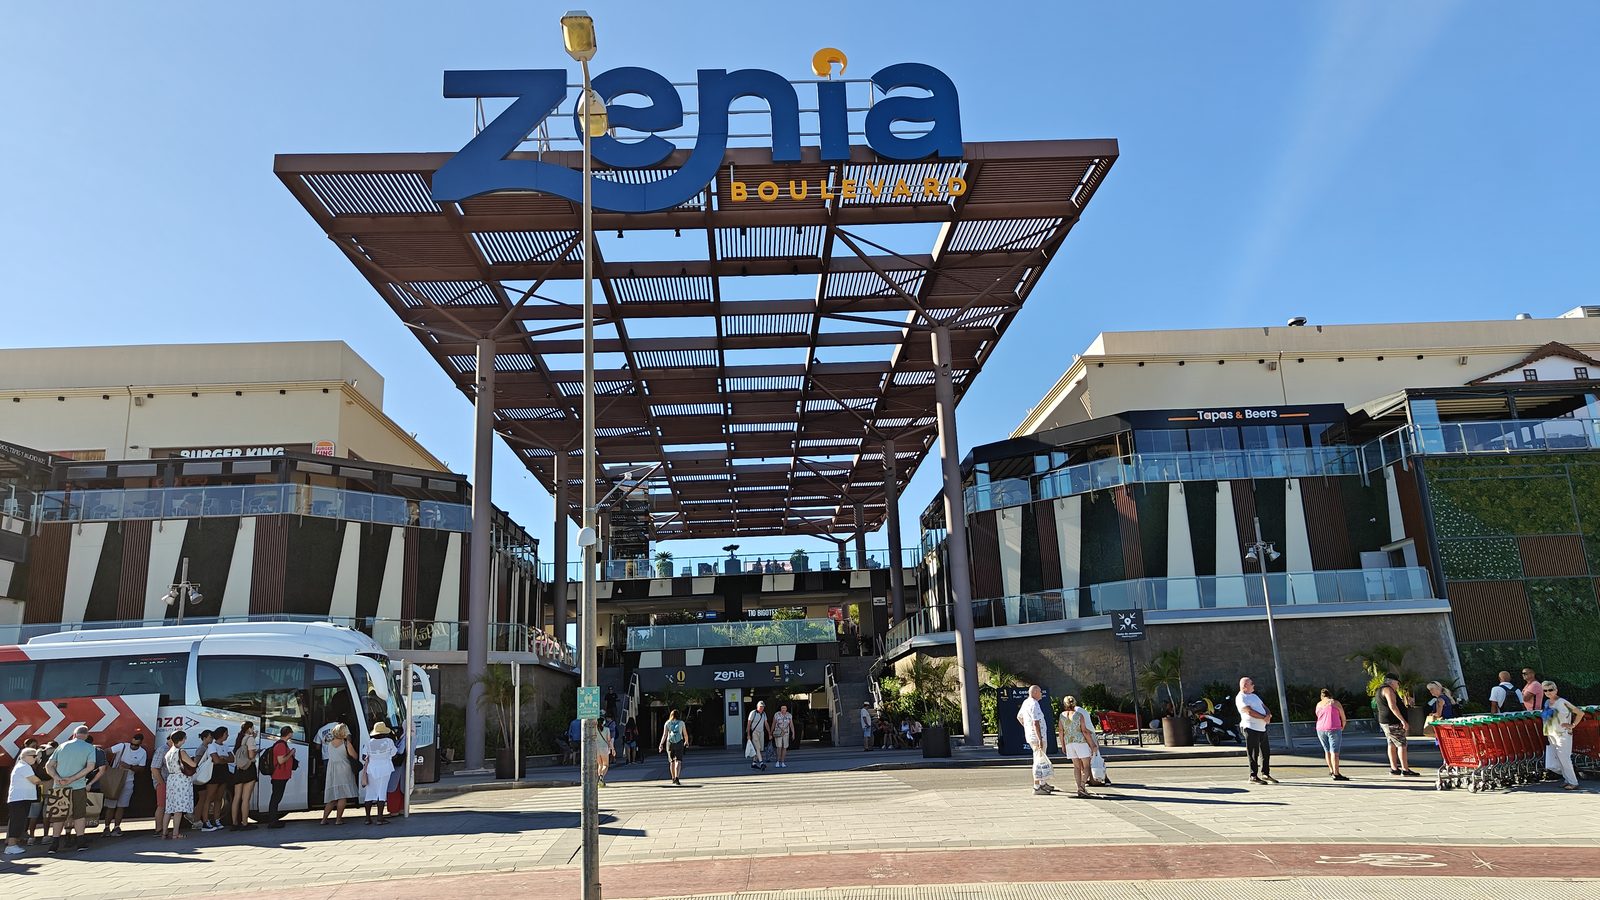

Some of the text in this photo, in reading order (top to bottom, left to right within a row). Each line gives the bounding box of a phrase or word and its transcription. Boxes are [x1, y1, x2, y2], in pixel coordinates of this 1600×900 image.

[731, 177, 968, 202] BOULEVARD
[1197, 409, 1278, 422] Tapas & Beers
[180, 447, 285, 458] BURGER KING
